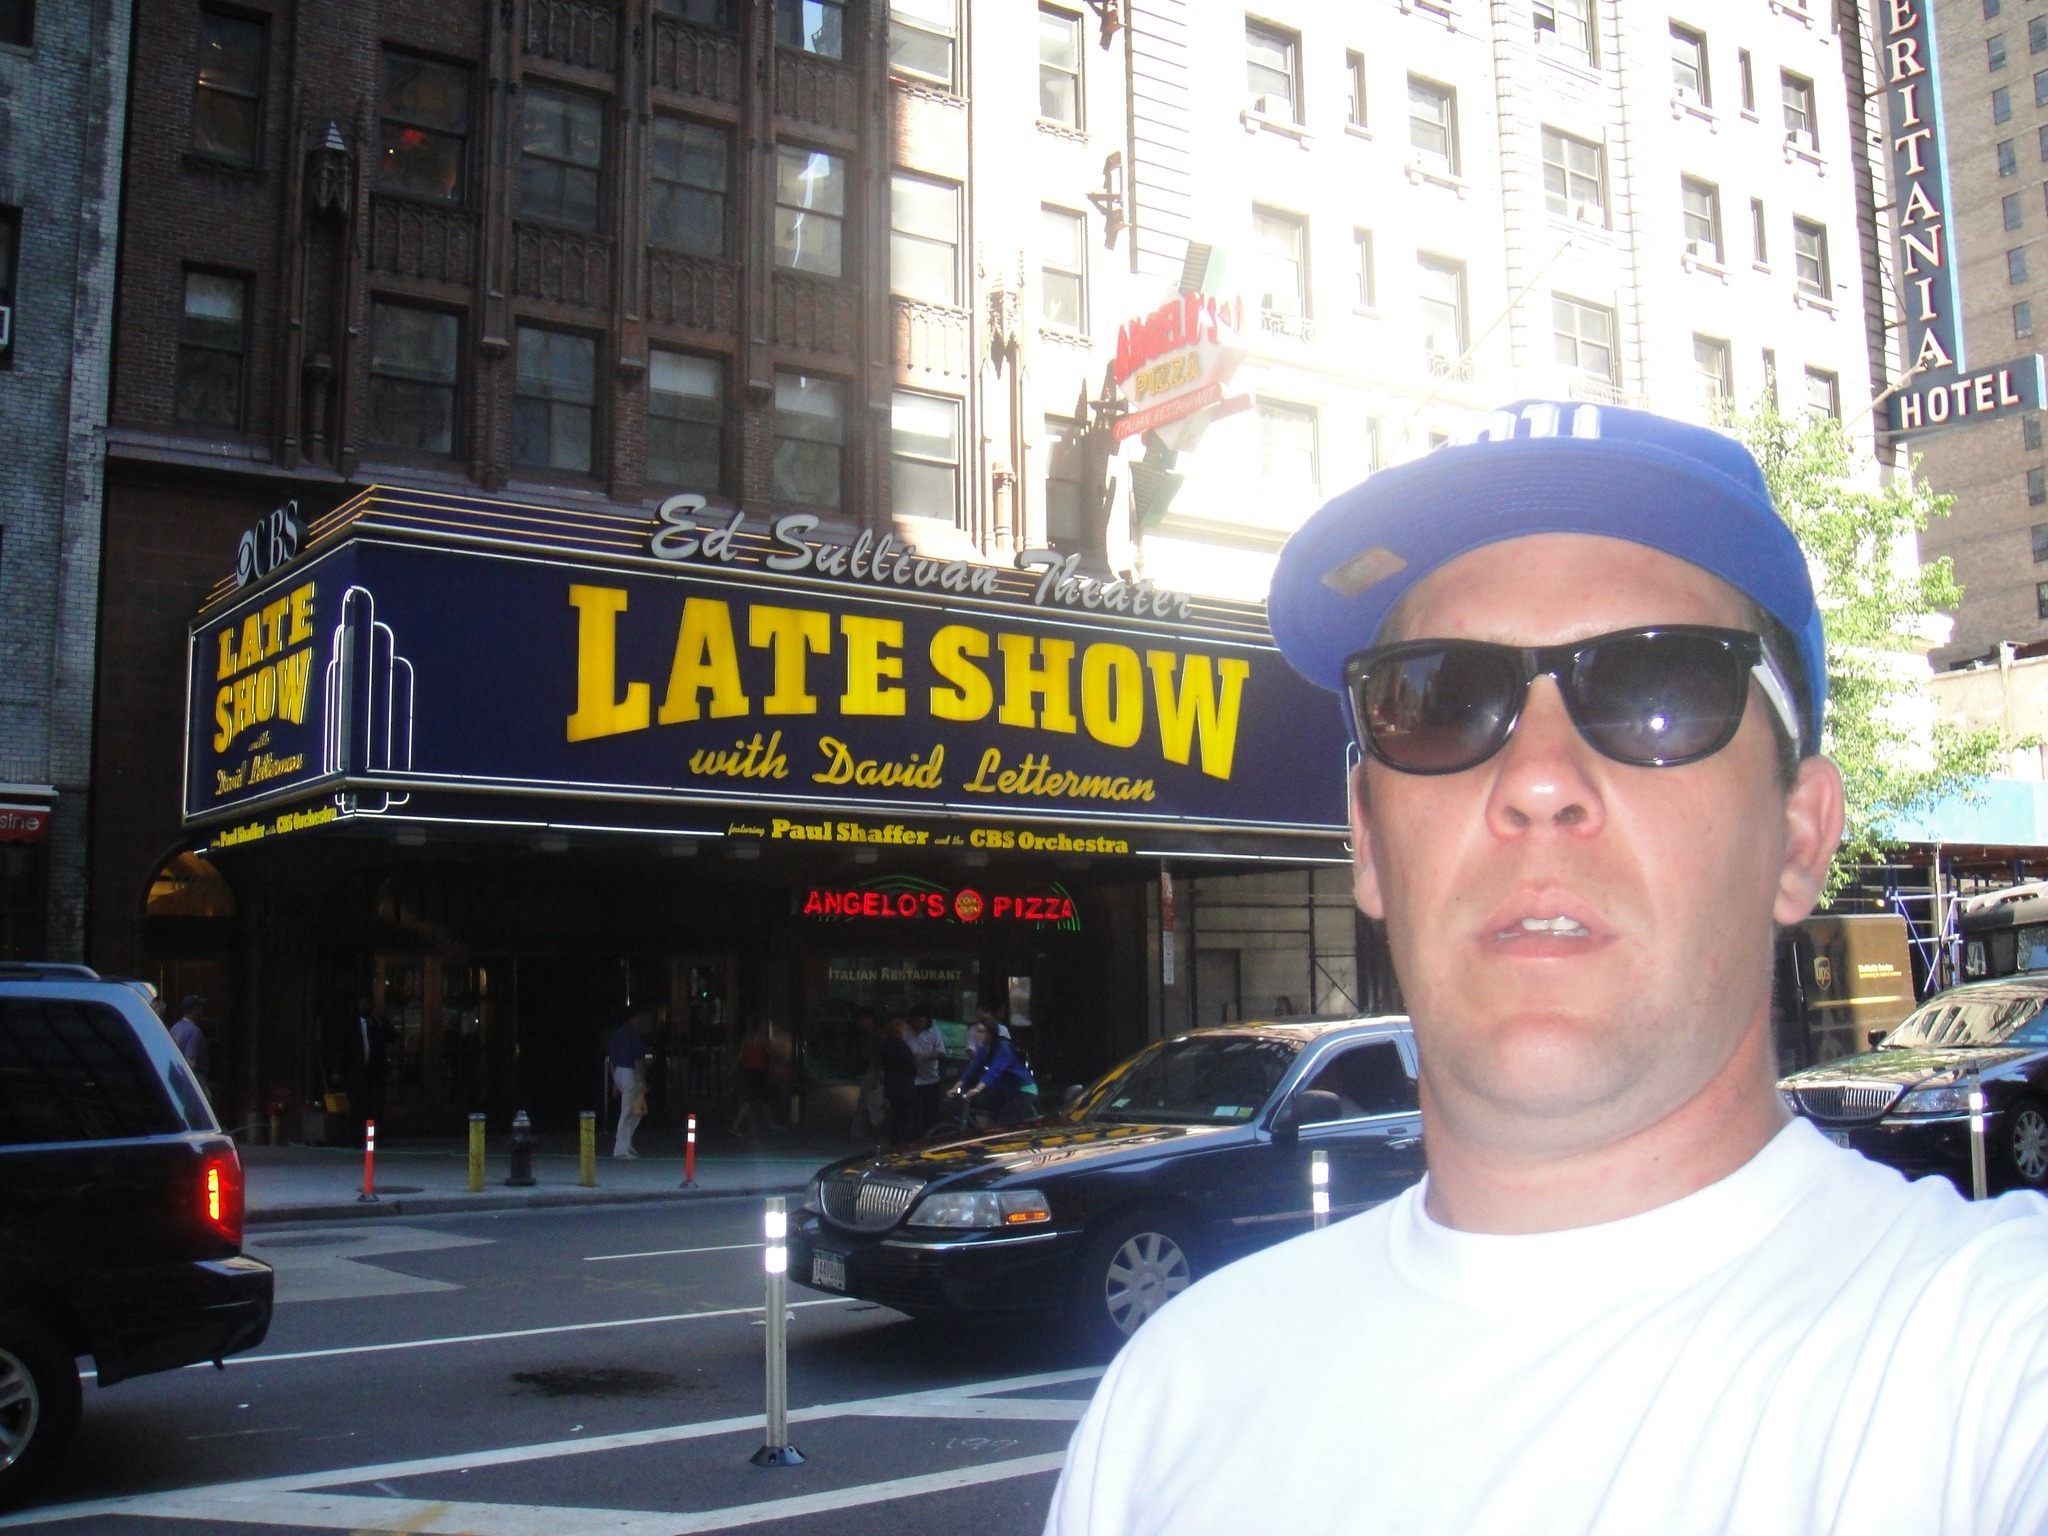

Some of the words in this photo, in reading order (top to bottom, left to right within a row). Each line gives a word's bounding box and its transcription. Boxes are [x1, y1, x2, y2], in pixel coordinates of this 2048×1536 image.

[1134, 351, 1201, 401] PIZZA
[1900, 369, 2021, 430] HOTEL
[1115, 411, 1151, 438] ITALIAN
[1153, 385, 1216, 422] RESTAURANT
[253, 500, 298, 579] CBS
[651, 493, 745, 563] Ed
[766, 513, 999, 594] Sullivan
[1016, 547, 1193, 620] Theater
[217, 581, 316, 682] LATE
[213, 647, 312, 753] SHOW
[567, 584, 906, 743] LATE
[930, 624, 1250, 781] SHOW
[215, 760, 247, 795] David
[248, 752, 303, 785] Letterman
[689, 730, 789, 779] with
[812, 735, 945, 789] David
[963, 747, 1156, 802] Letterman
[276, 813, 294, 834] CBS
[293, 805, 337, 830] Orchestra
[728, 822, 766, 837] featuring
[771, 818, 832, 841] Paul
[836, 822, 929, 845] Shaffer
[934, 834, 950, 845] and
[951, 834, 965, 846] the
[970, 828, 1015, 849] CBS
[1018, 831, 1129, 855] Orchestra
[804, 890, 945, 917] ANGELO'S
[993, 896, 1074, 919] PIZZA
